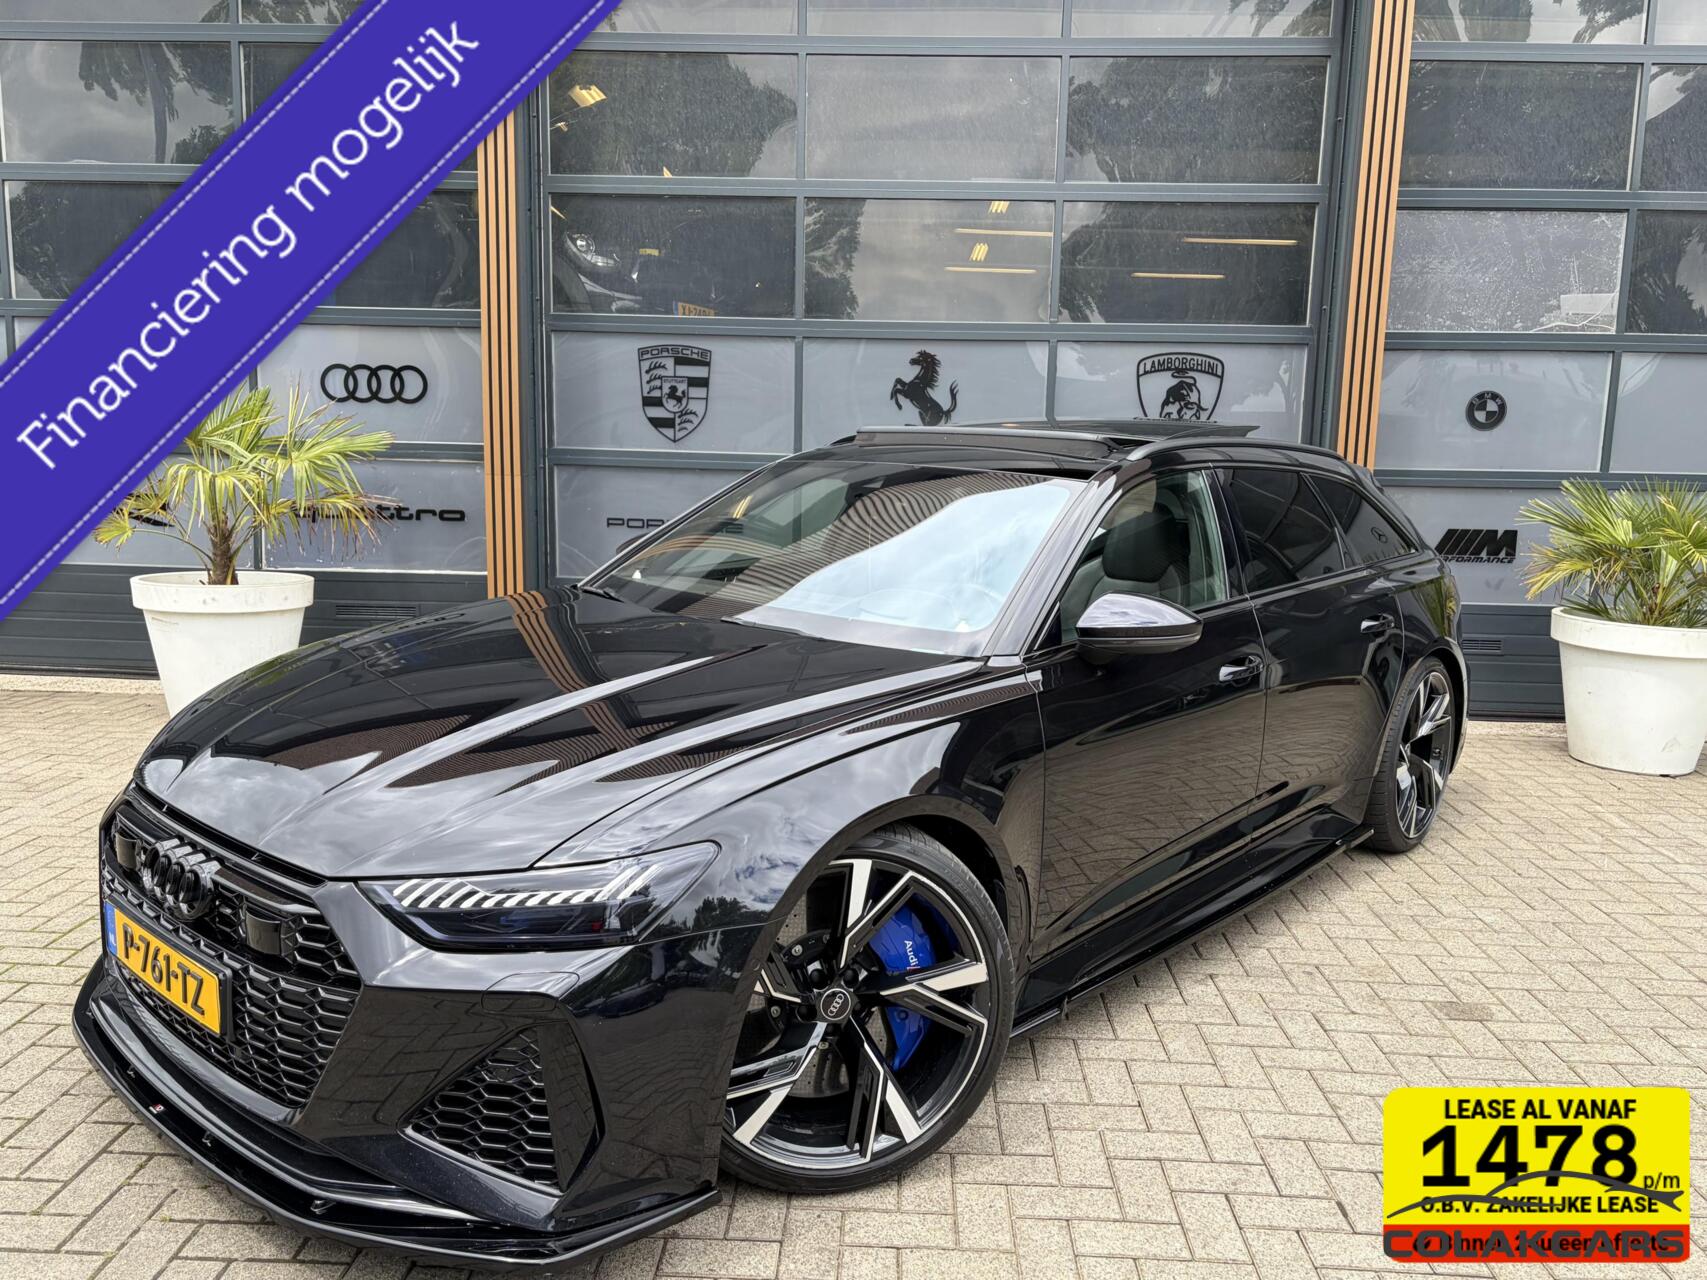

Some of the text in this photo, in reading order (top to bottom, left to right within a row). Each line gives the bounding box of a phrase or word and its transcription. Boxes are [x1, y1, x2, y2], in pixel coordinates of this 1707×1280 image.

[640, 347, 709, 360] PORSCHE
[1143, 356, 1219, 376] LAMBORGHINI
[903, 939, 919, 967] Audi
[122, 922, 206, 1017] P-761-TZ
